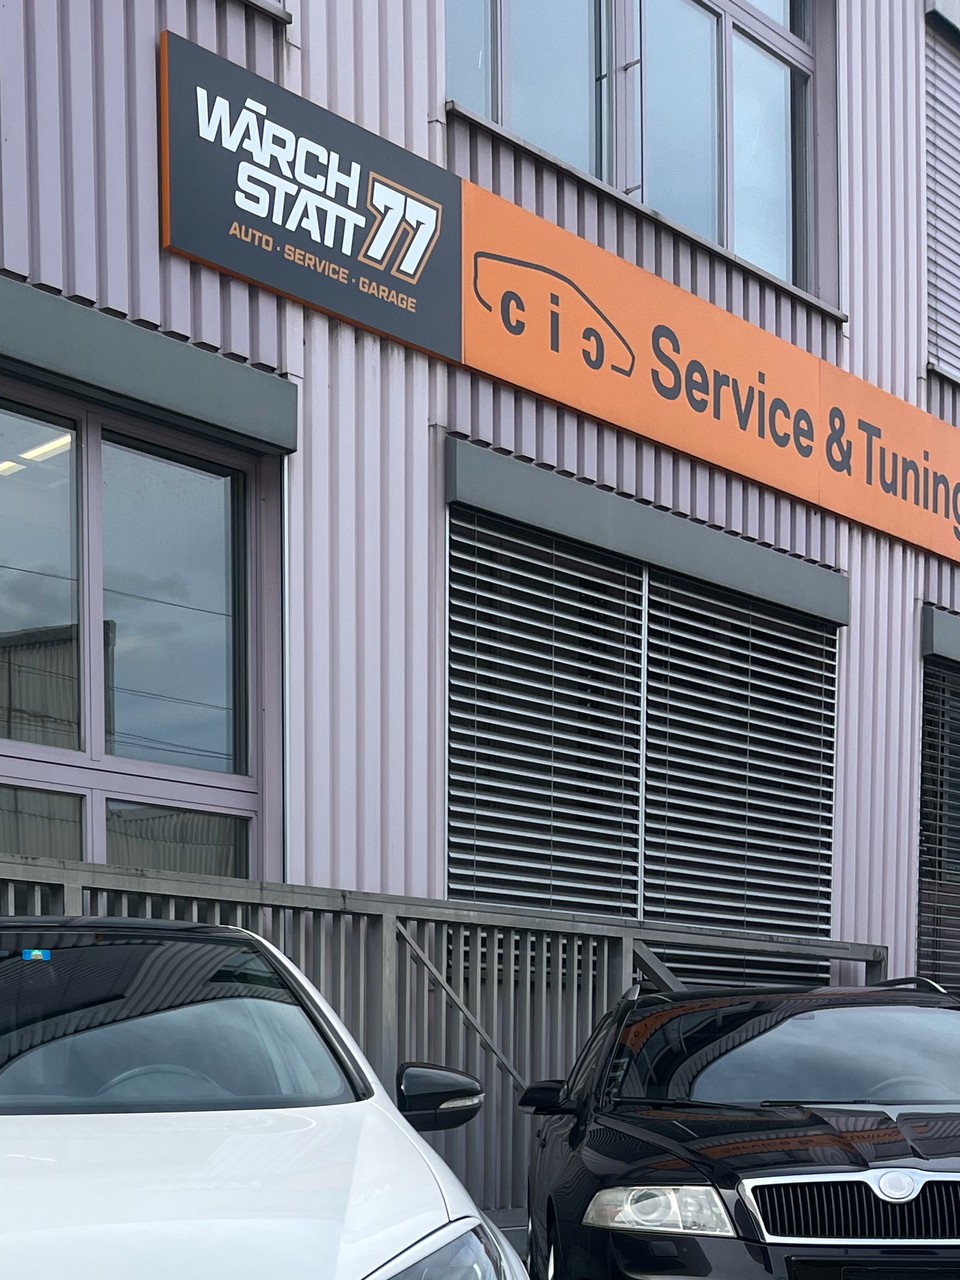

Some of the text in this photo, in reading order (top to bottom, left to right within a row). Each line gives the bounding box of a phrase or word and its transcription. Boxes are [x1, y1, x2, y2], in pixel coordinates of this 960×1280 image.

[228, 221, 417, 313] AUTO SERVICE GARAGE
[359, 173, 441, 283] 77
[651, 324, 814, 458] Service
[825, 406, 852, 477] &
